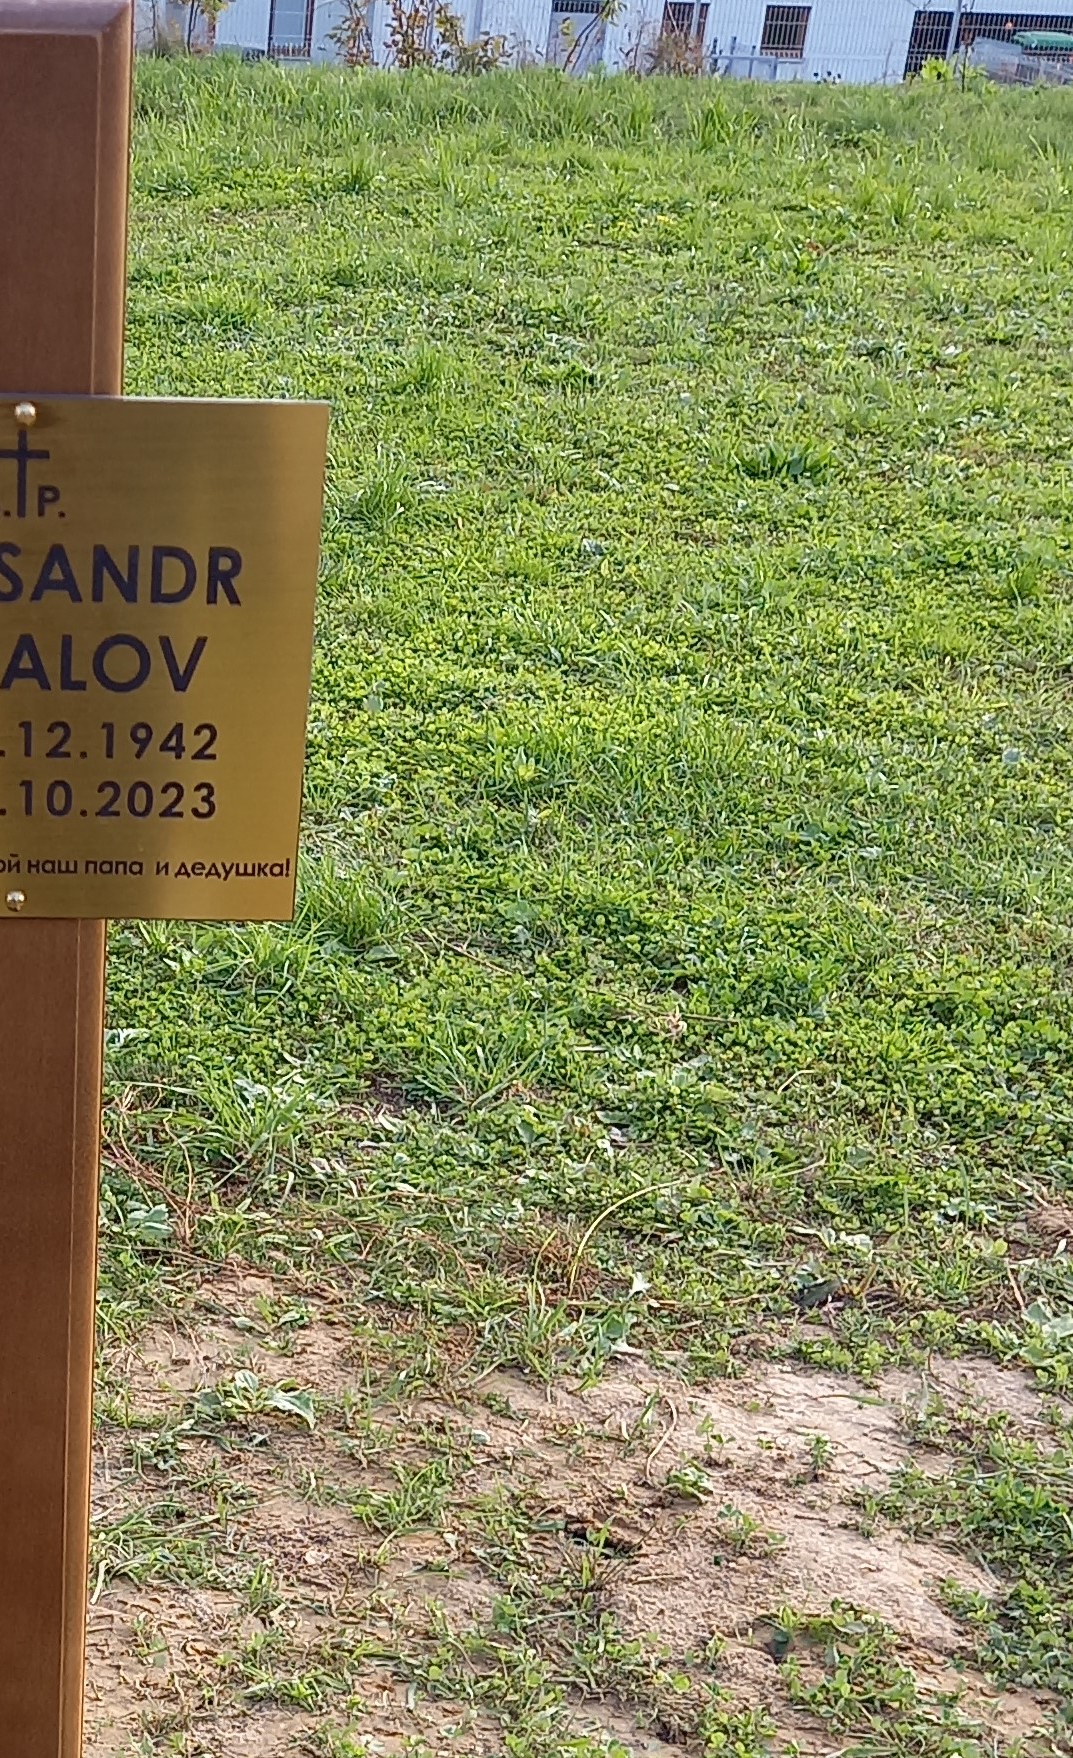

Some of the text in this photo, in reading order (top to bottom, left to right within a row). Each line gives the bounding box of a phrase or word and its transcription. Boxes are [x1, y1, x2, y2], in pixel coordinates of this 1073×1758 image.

[27, 859, 79, 875] наш
[84, 859, 145, 877] папа
[155, 860, 170, 877] и
[173, 857, 291, 881] дедушка!
